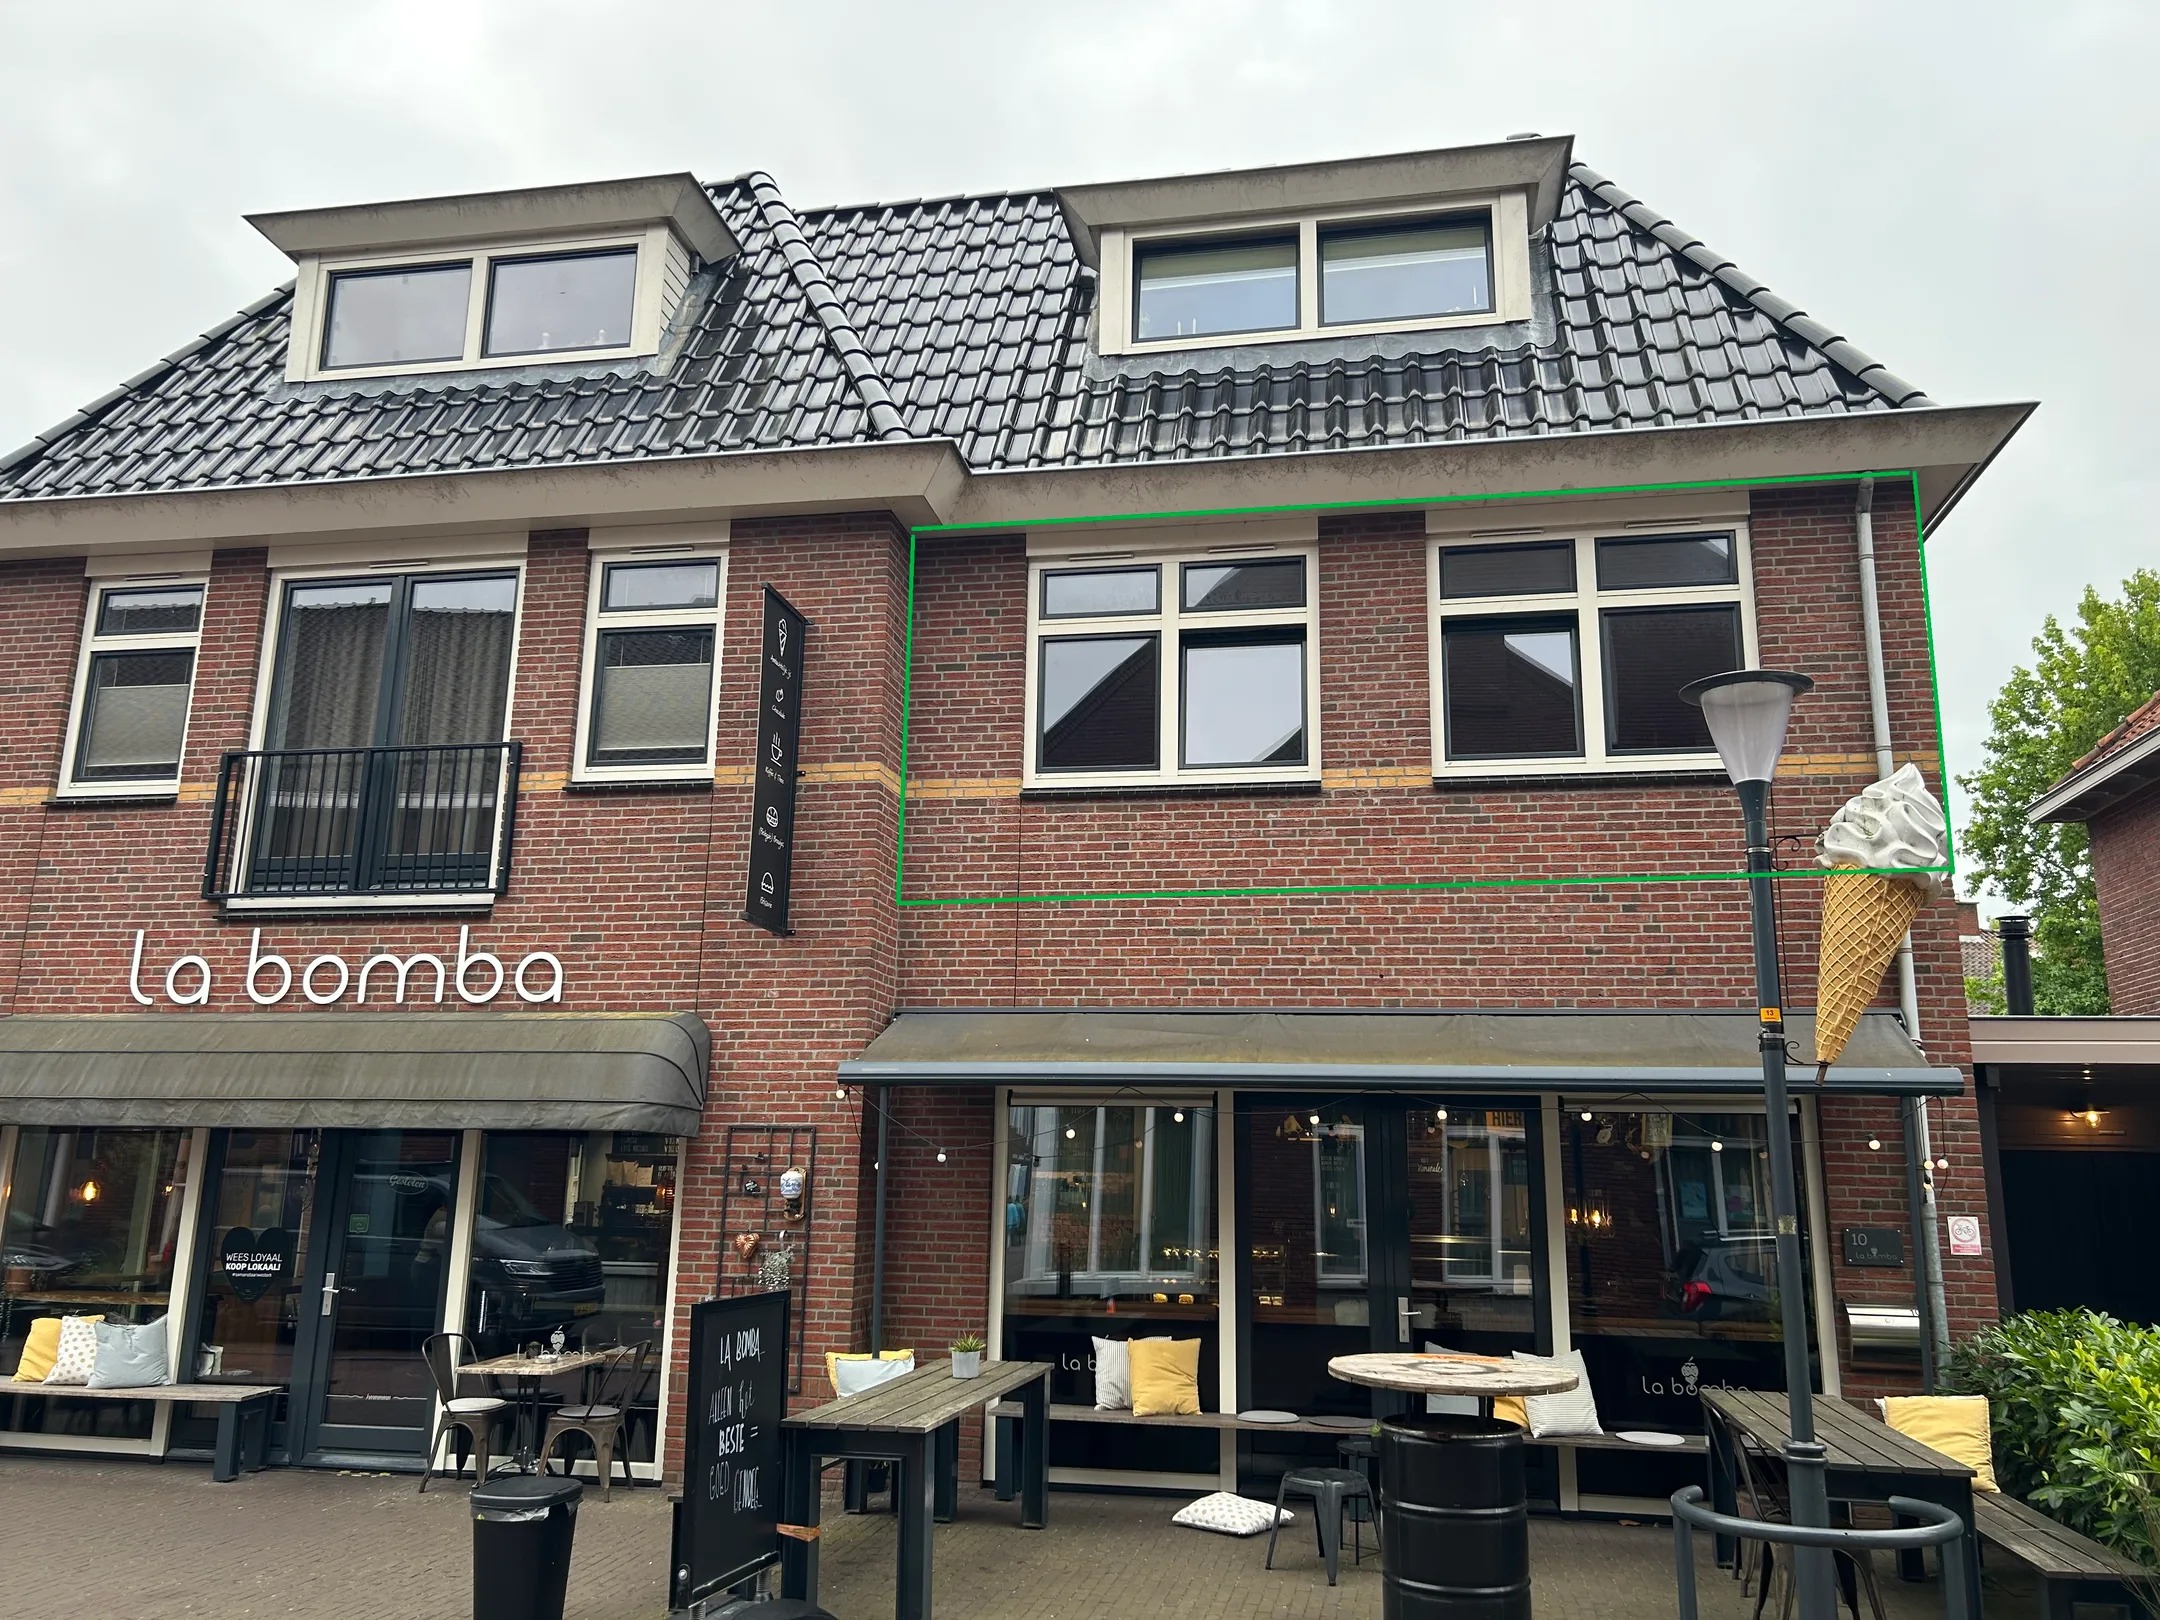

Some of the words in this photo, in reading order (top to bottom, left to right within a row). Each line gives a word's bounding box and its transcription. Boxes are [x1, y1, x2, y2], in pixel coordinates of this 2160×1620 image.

[130, 929, 212, 1005] la
[246, 925, 564, 1004] bomba
[389, 1175, 426, 1189] Gesloten
[1851, 1233, 1868, 1246] 10
[226, 1252, 250, 1262] WEES
[250, 1253, 283, 1262] LOYAAL
[1867, 1251, 1898, 1260] bomba
[225, 1262, 247, 1271] KOOP
[720, 1333, 732, 1371] LA
[735, 1327, 761, 1362] BOMBA
[1062, 1352, 1081, 1371] la
[1642, 1375, 1664, 1395] la
[708, 1385, 733, 1425] ALLEEN
[718, 1422, 745, 1457] BESTE
[709, 1460, 730, 1501] GOED
